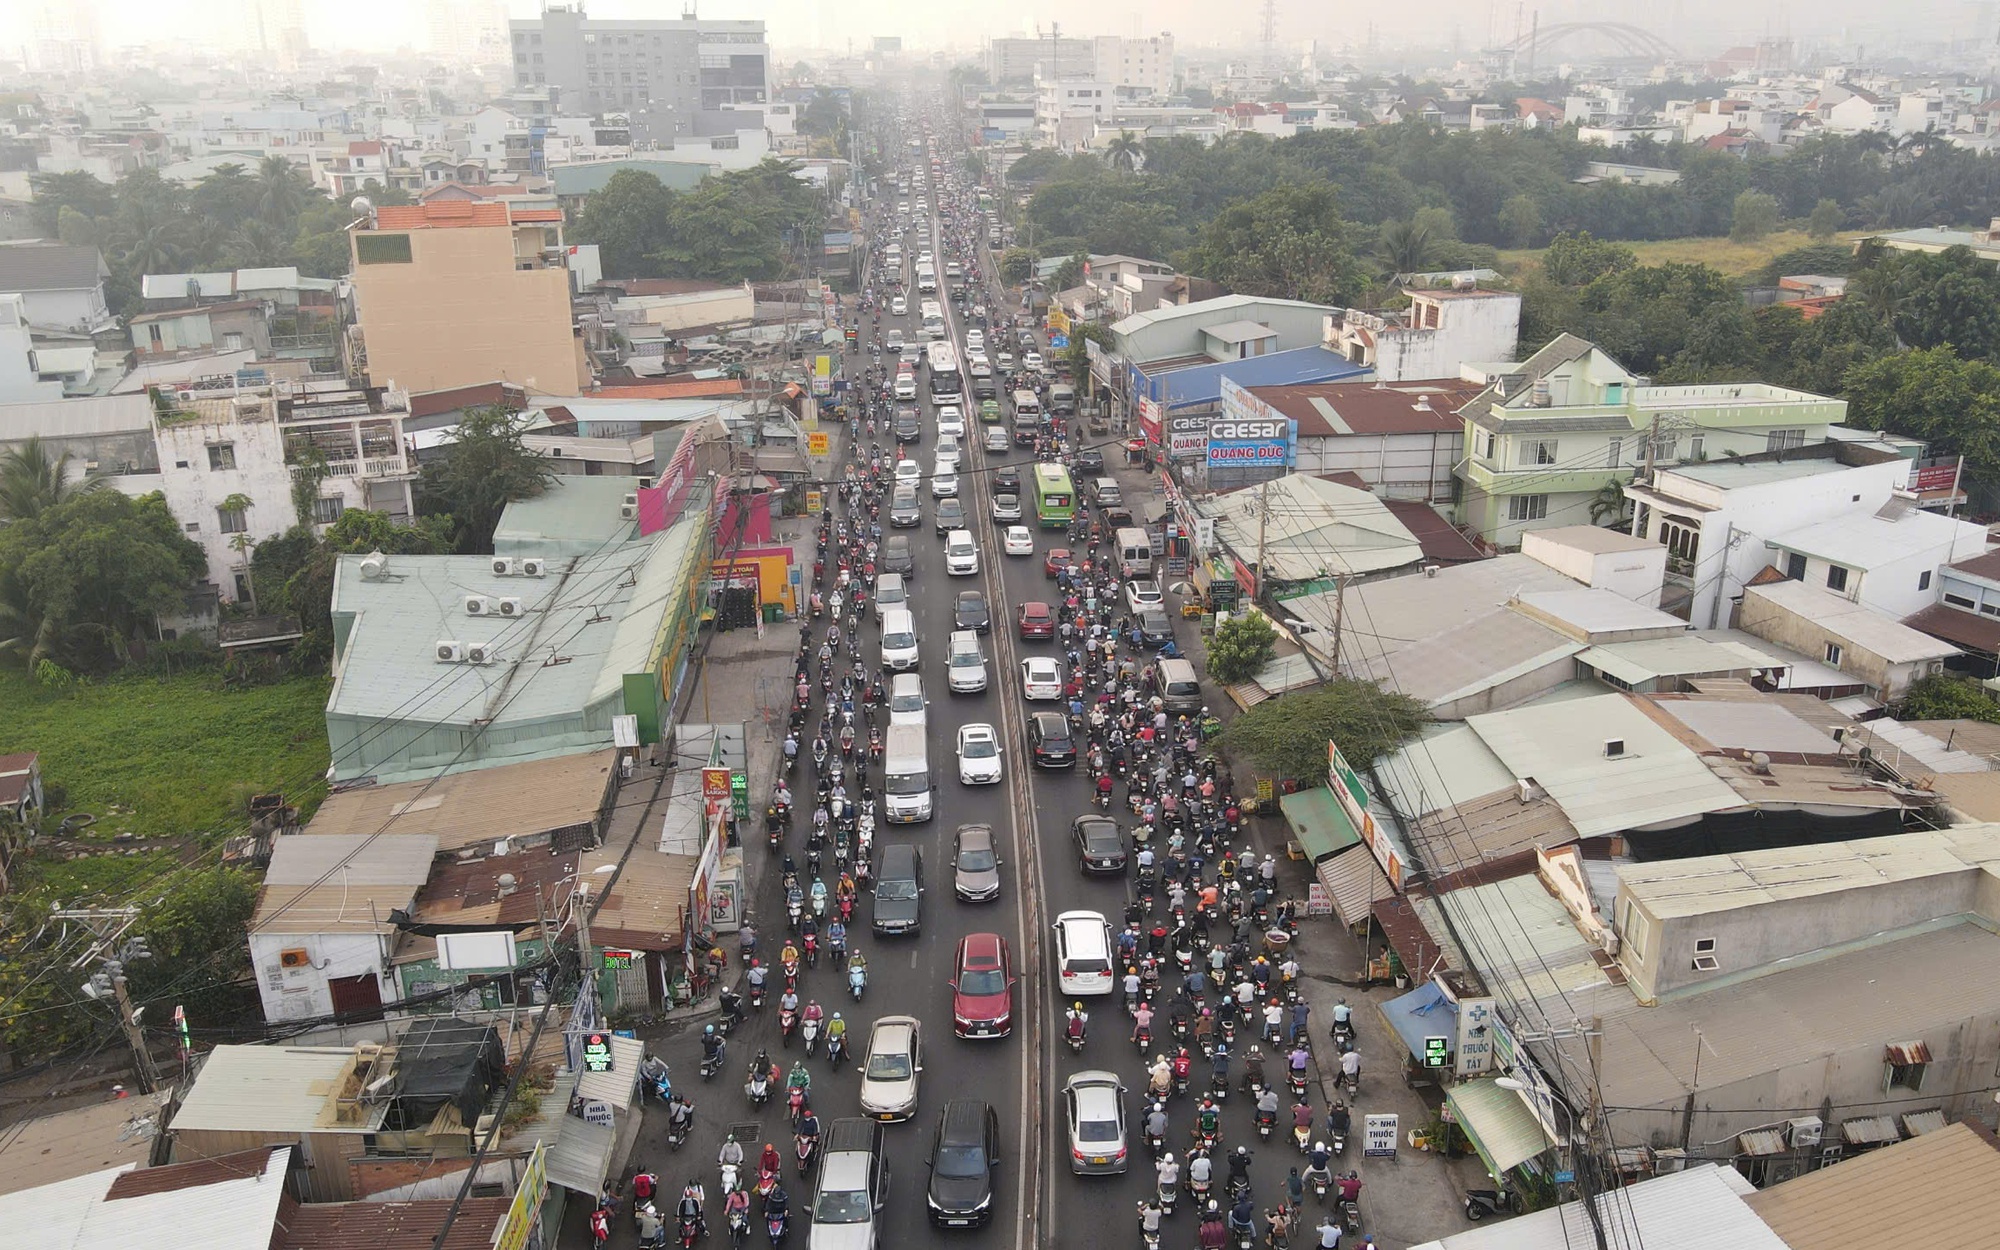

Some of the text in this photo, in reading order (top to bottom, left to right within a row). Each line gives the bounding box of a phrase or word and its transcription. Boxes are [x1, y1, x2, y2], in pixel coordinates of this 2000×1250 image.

[1173, 415, 1221, 430] caes
[1211, 422, 1286, 439] caesar
[1173, 437, 1201, 449] QUANG
[1210, 446, 1254, 459] QUANG
[1258, 443, 1284, 458] ĐỨC
[605, 956, 631, 969] HOTEL
[1463, 1039, 1489, 1055] THUỐC
[586, 1112, 612, 1122] THUỐC
[1369, 1128, 1394, 1138] THUỐC
[1373, 1140, 1388, 1149] TÂY
